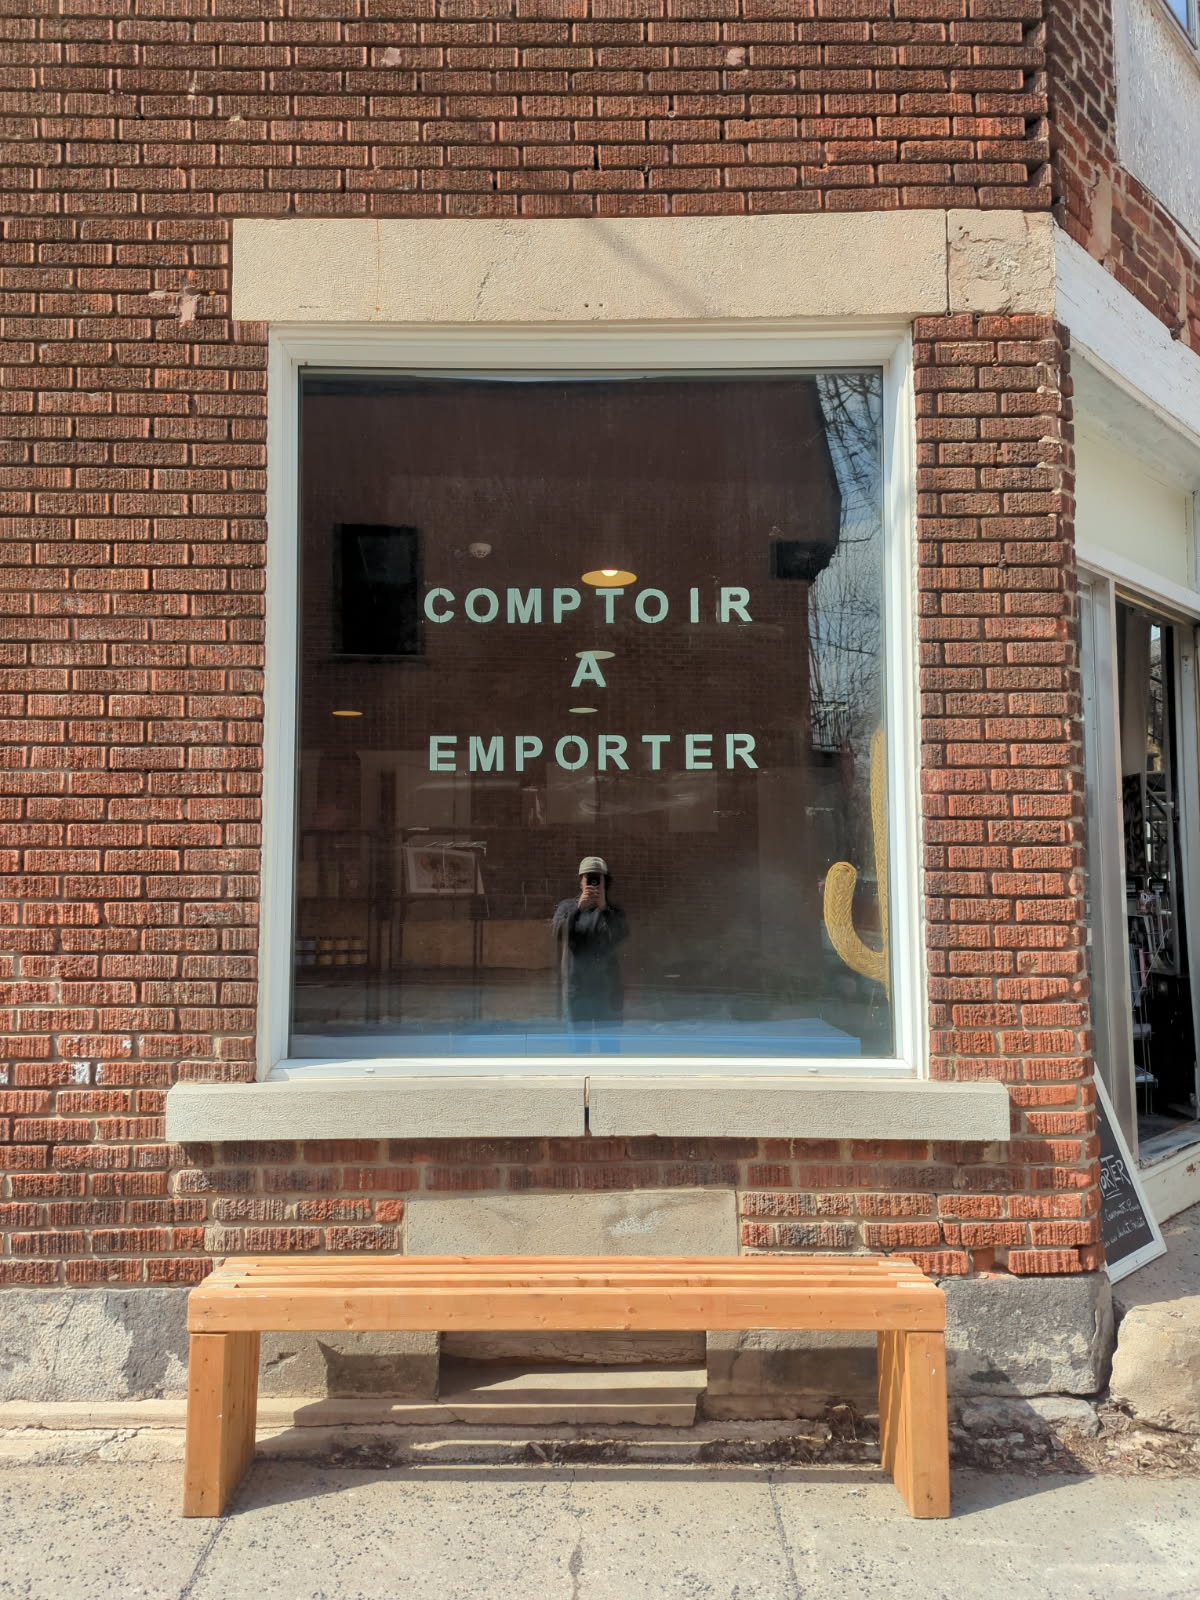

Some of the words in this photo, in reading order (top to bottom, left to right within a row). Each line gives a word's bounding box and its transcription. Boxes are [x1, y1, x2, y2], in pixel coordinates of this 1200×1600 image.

[423, 586, 753, 624] COMPTOIR
[571, 651, 607, 688] A
[429, 733, 759, 772] EMPORTER
